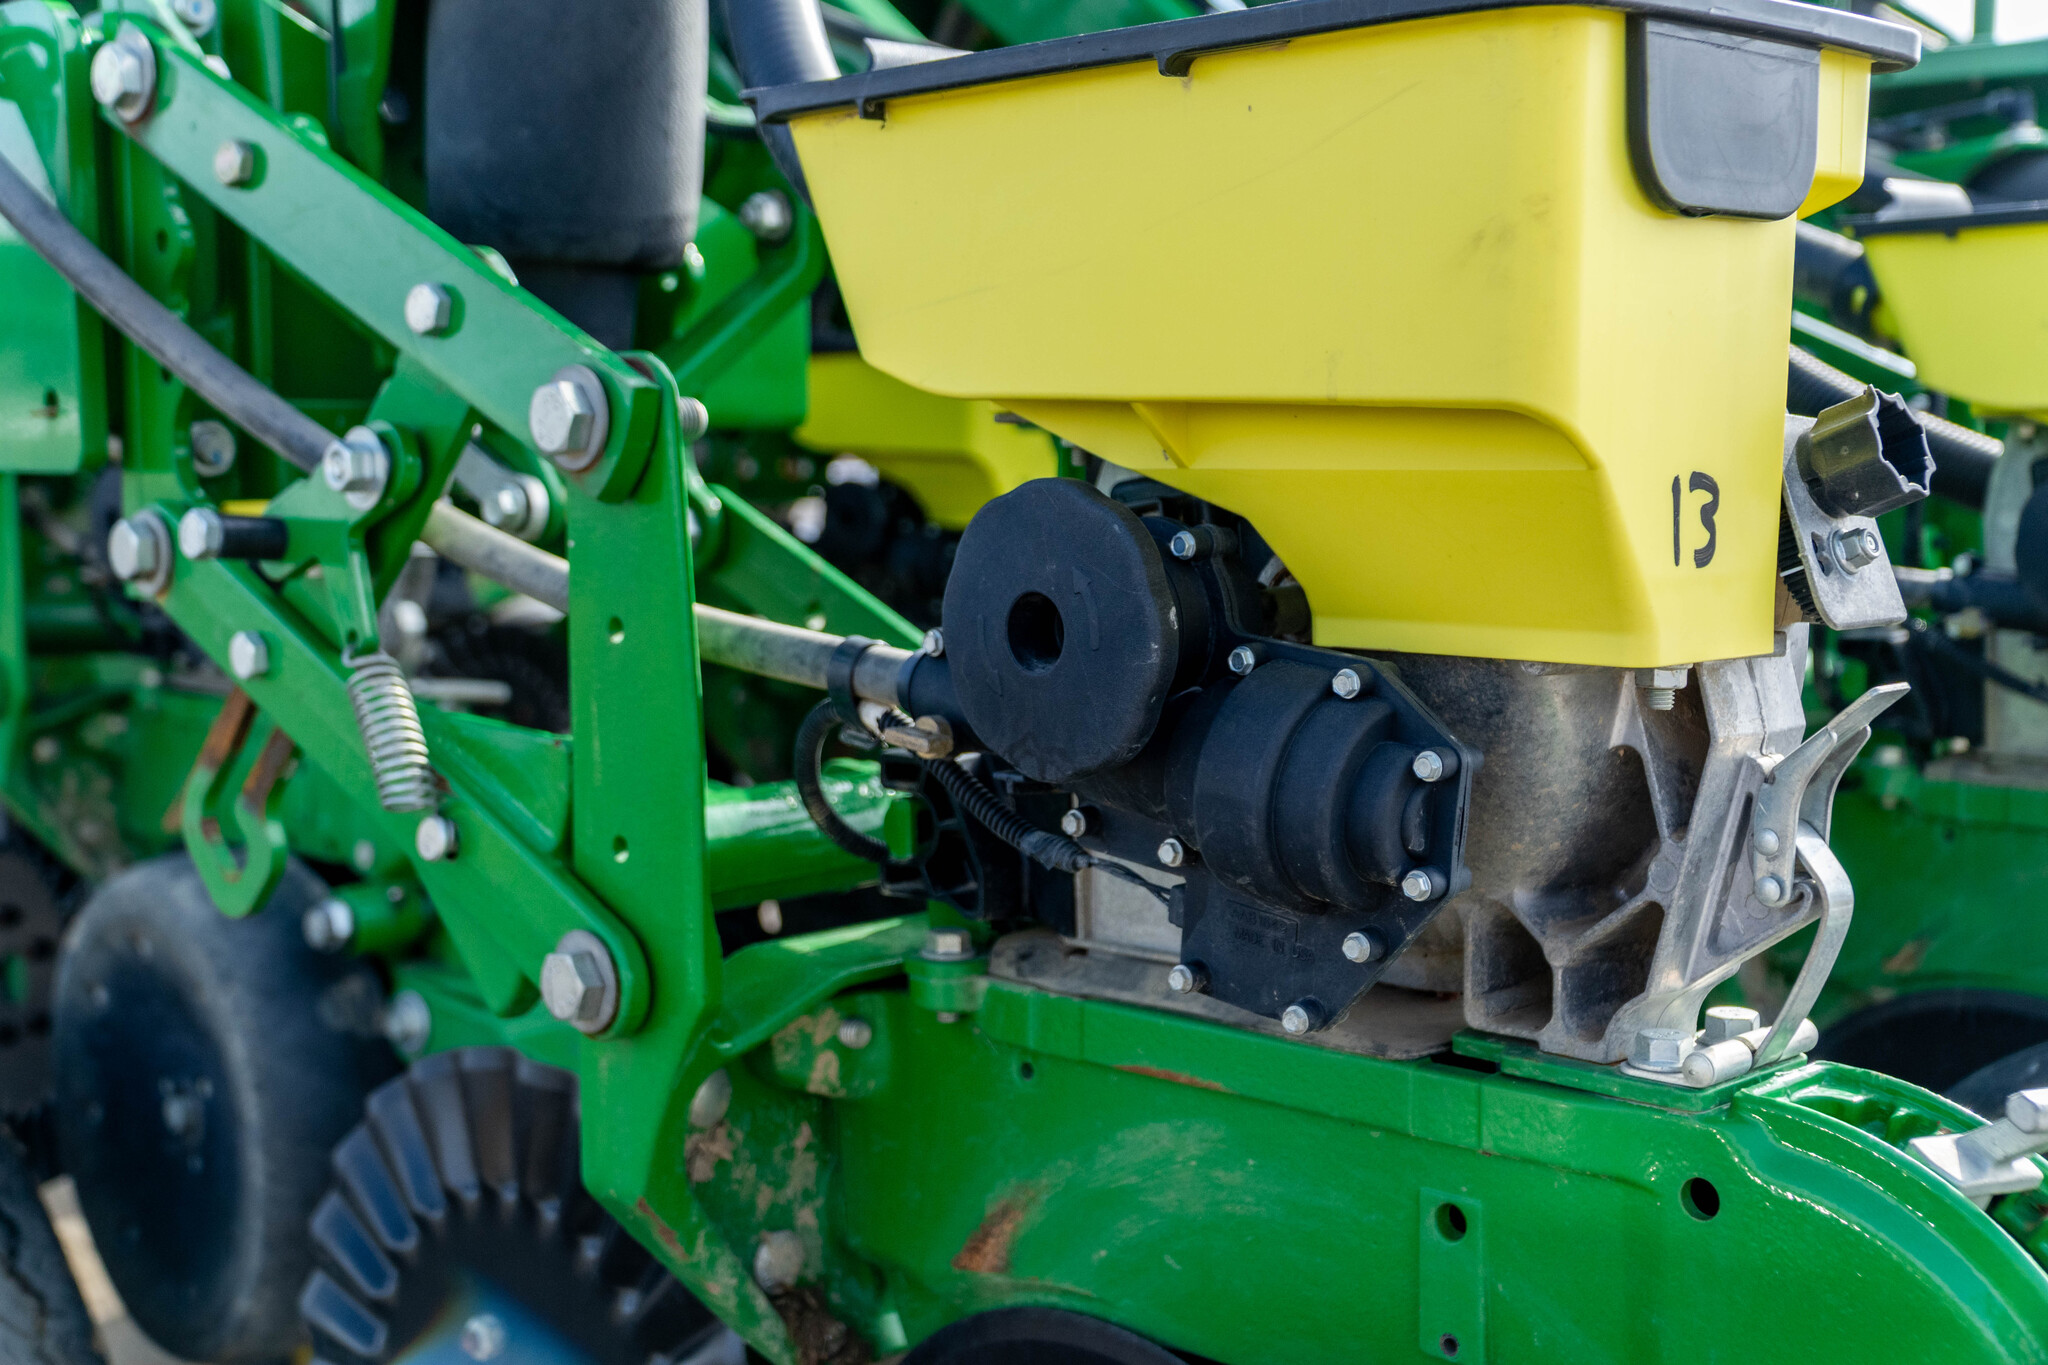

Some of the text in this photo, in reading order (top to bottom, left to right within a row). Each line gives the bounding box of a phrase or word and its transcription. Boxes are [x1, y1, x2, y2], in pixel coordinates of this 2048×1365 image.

[1671, 470, 1720, 569] 13
[1233, 926, 1315, 964] MADE IN USA
